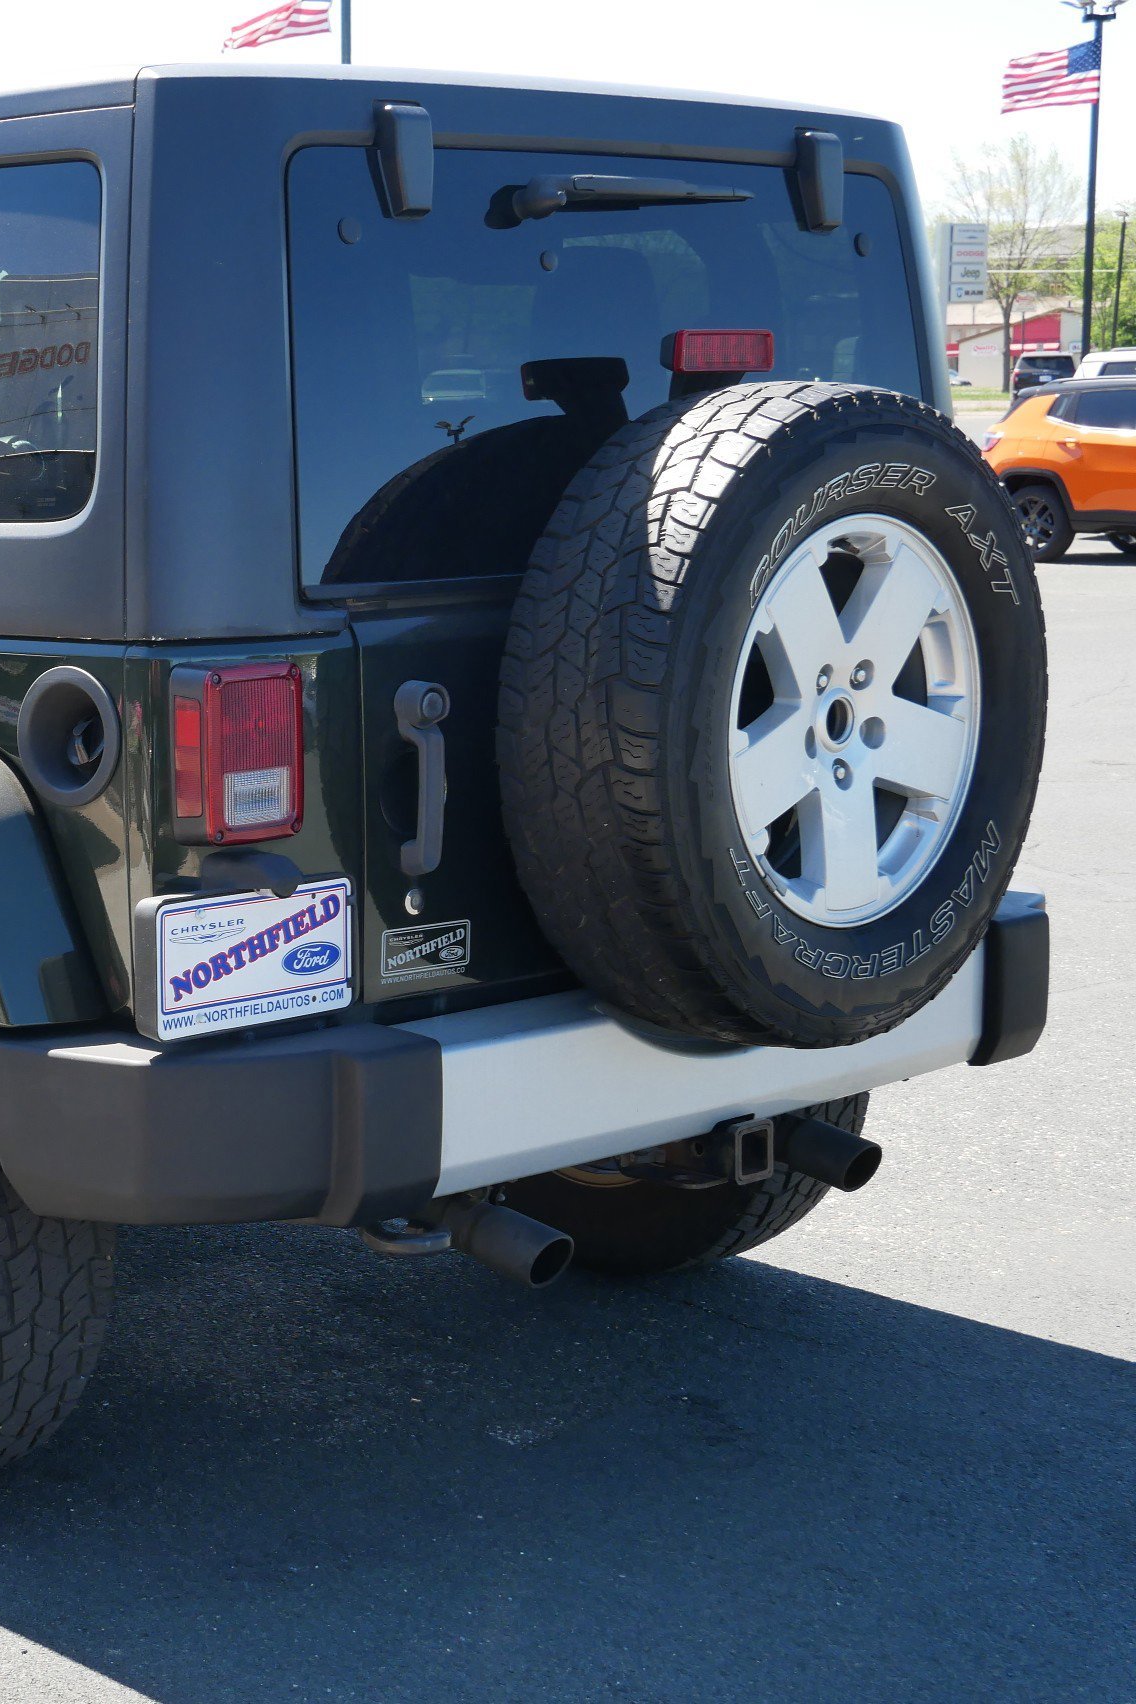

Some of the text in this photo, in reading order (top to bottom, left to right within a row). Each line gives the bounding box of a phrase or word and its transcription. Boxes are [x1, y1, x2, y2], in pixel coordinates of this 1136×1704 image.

[960, 266, 981, 280] Jeep
[748, 462, 1020, 609] COURSER AXT
[729, 819, 1003, 980] MASTERCRAFT
[169, 893, 341, 1003] NORTHFIELD
[171, 918, 245, 936] CHRYSLER
[387, 927, 465, 970] NORTHFIELD
[293, 945, 331, 970] Ford
